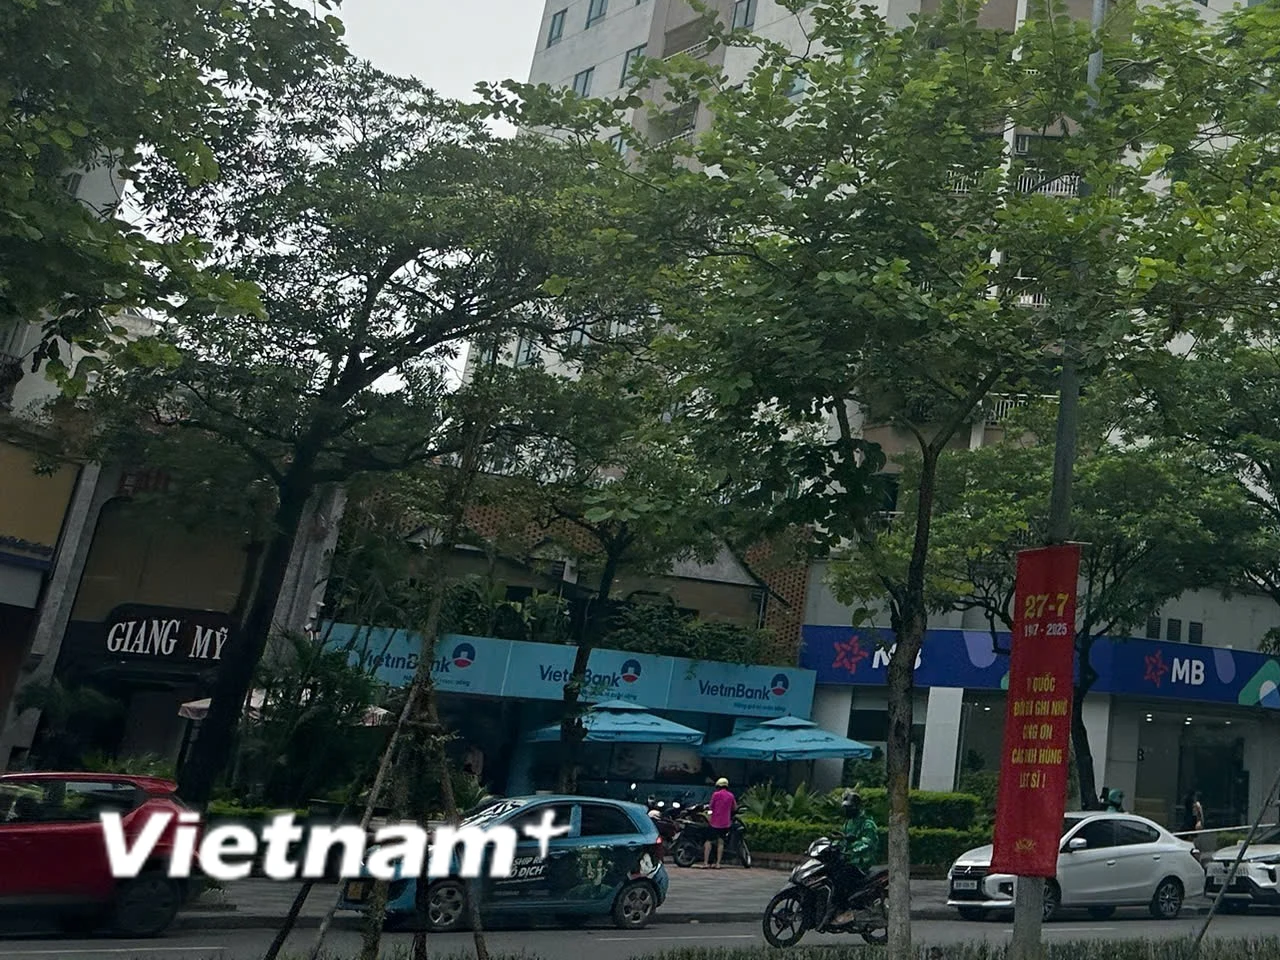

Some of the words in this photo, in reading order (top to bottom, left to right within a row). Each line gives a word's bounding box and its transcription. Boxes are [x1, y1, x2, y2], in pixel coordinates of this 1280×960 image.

[1024, 593, 1069, 619] 27-7
[107, 619, 180, 655] GIANG
[187, 625, 228, 660] MỸ
[1046, 623, 1068, 636] 2025
[1171, 657, 1205, 685] MB
[698, 679, 771, 700] VietinBank
[1035, 700, 1049, 716] GHI
